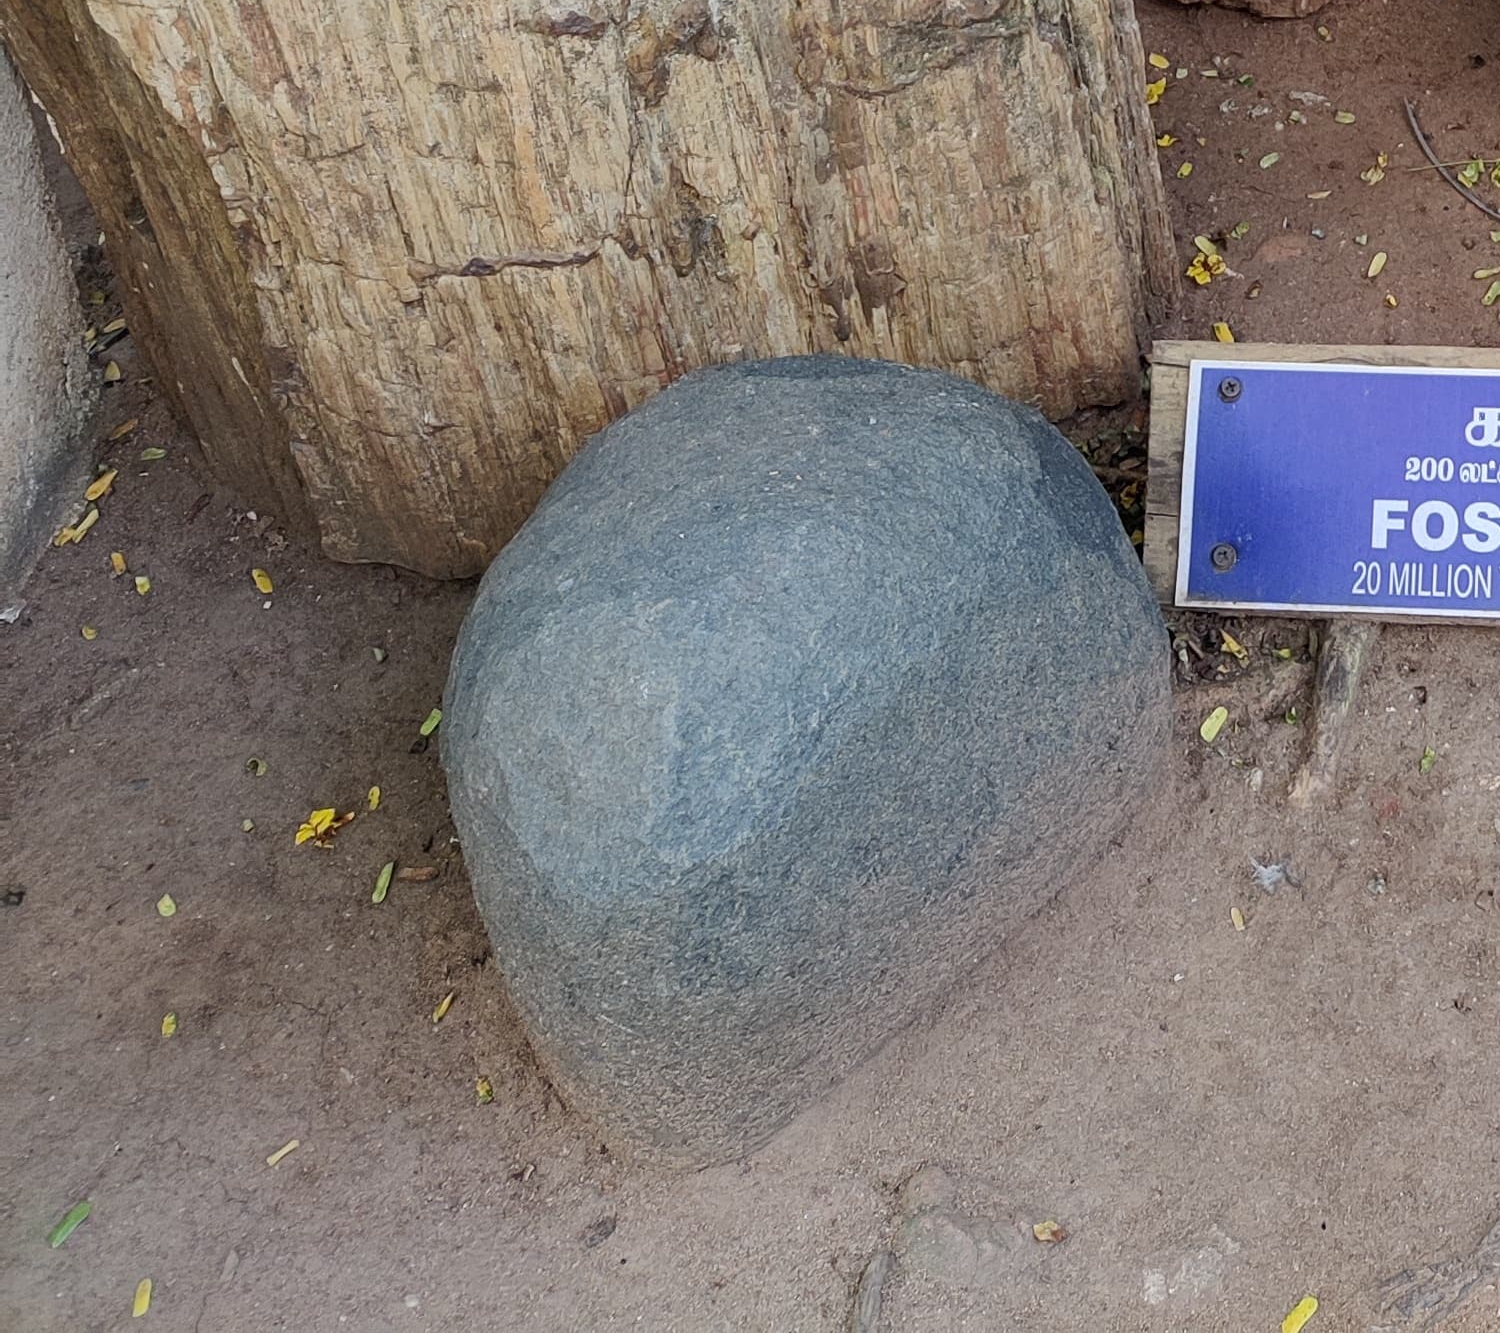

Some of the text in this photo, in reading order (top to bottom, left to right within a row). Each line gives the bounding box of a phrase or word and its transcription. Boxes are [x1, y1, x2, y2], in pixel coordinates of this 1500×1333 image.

[1404, 456, 1455, 482] 200
[1351, 561, 1381, 595] 20
[1388, 562, 1492, 599] MILLION
